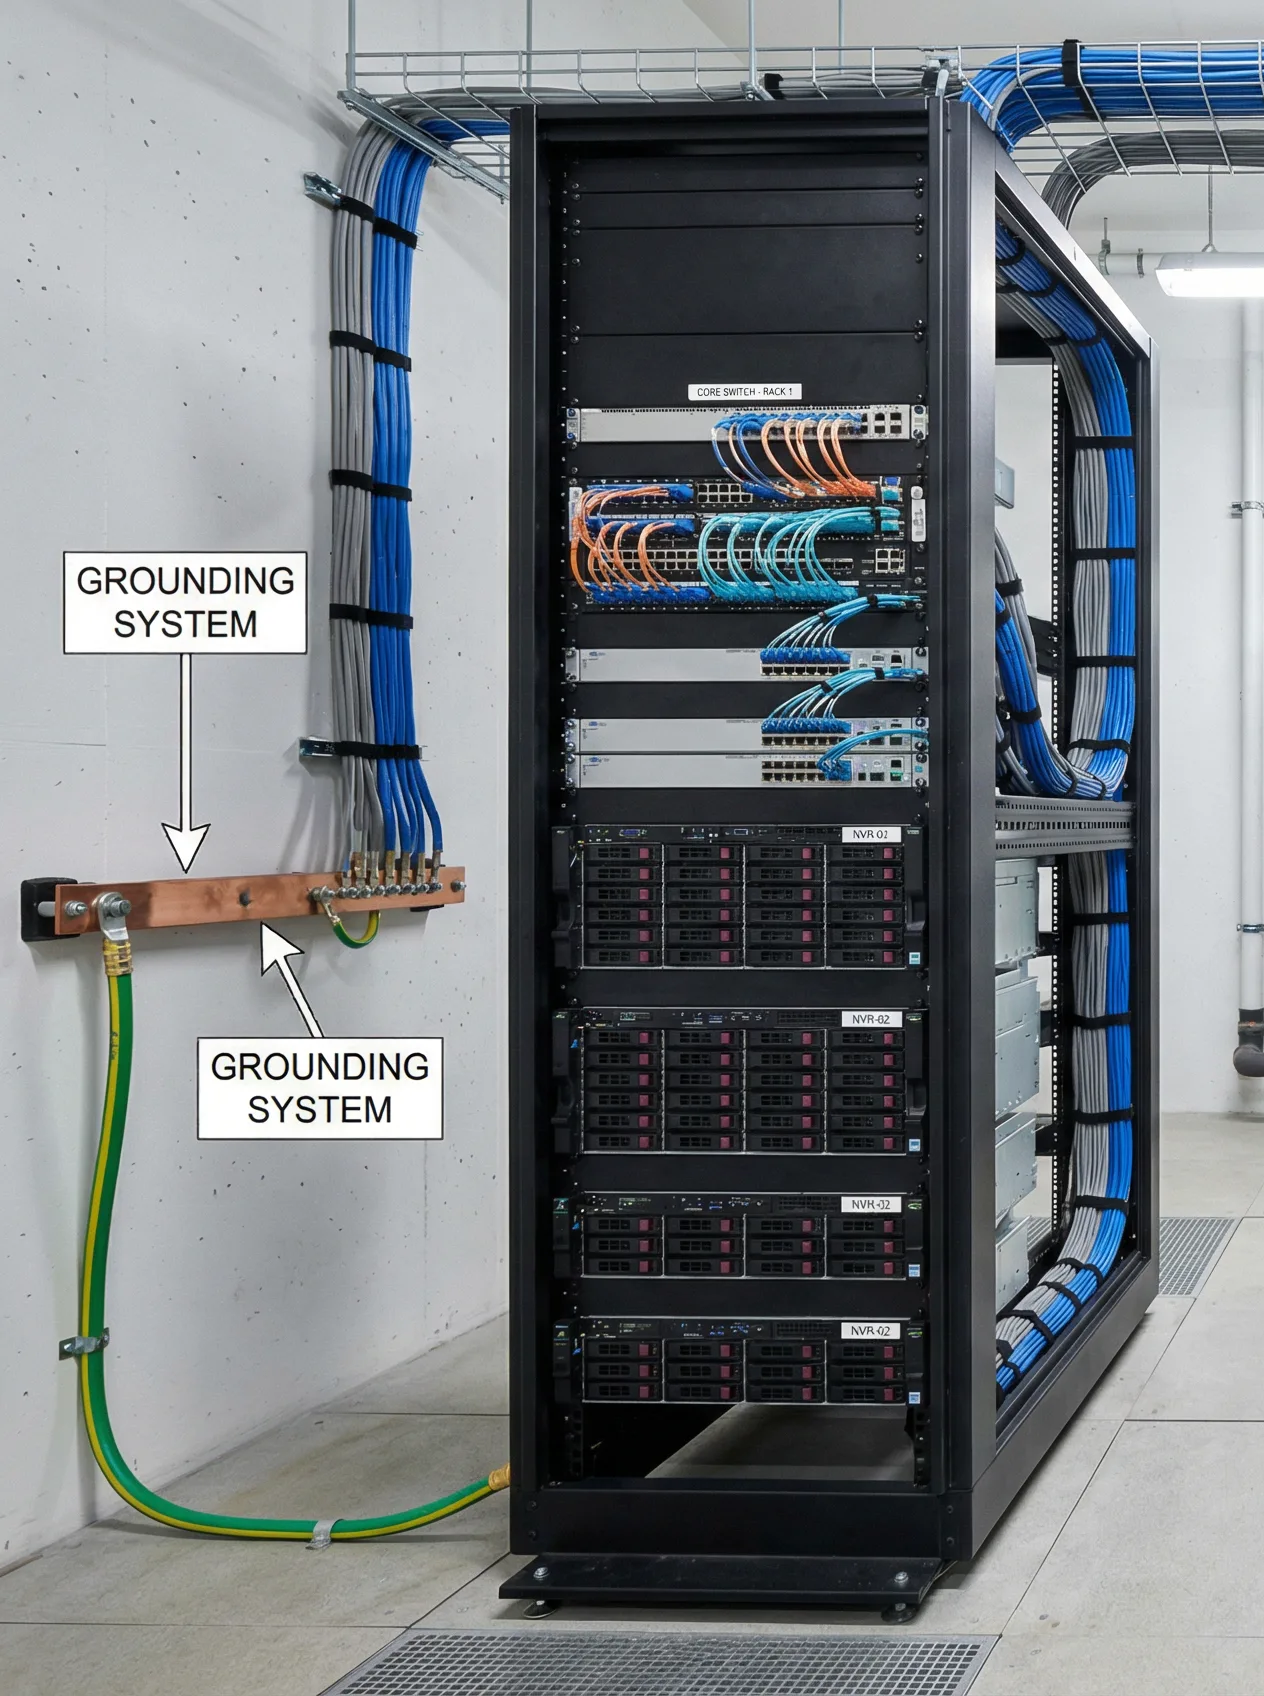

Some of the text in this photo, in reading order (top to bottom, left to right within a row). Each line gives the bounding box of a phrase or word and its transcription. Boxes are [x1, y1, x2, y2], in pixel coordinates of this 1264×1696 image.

[697, 387, 721, 397] CORE
[723, 387, 756, 397] SWITCH
[763, 387, 786, 396] RACK
[788, 387, 793, 396] 1
[853, 829, 875, 839] NVR
